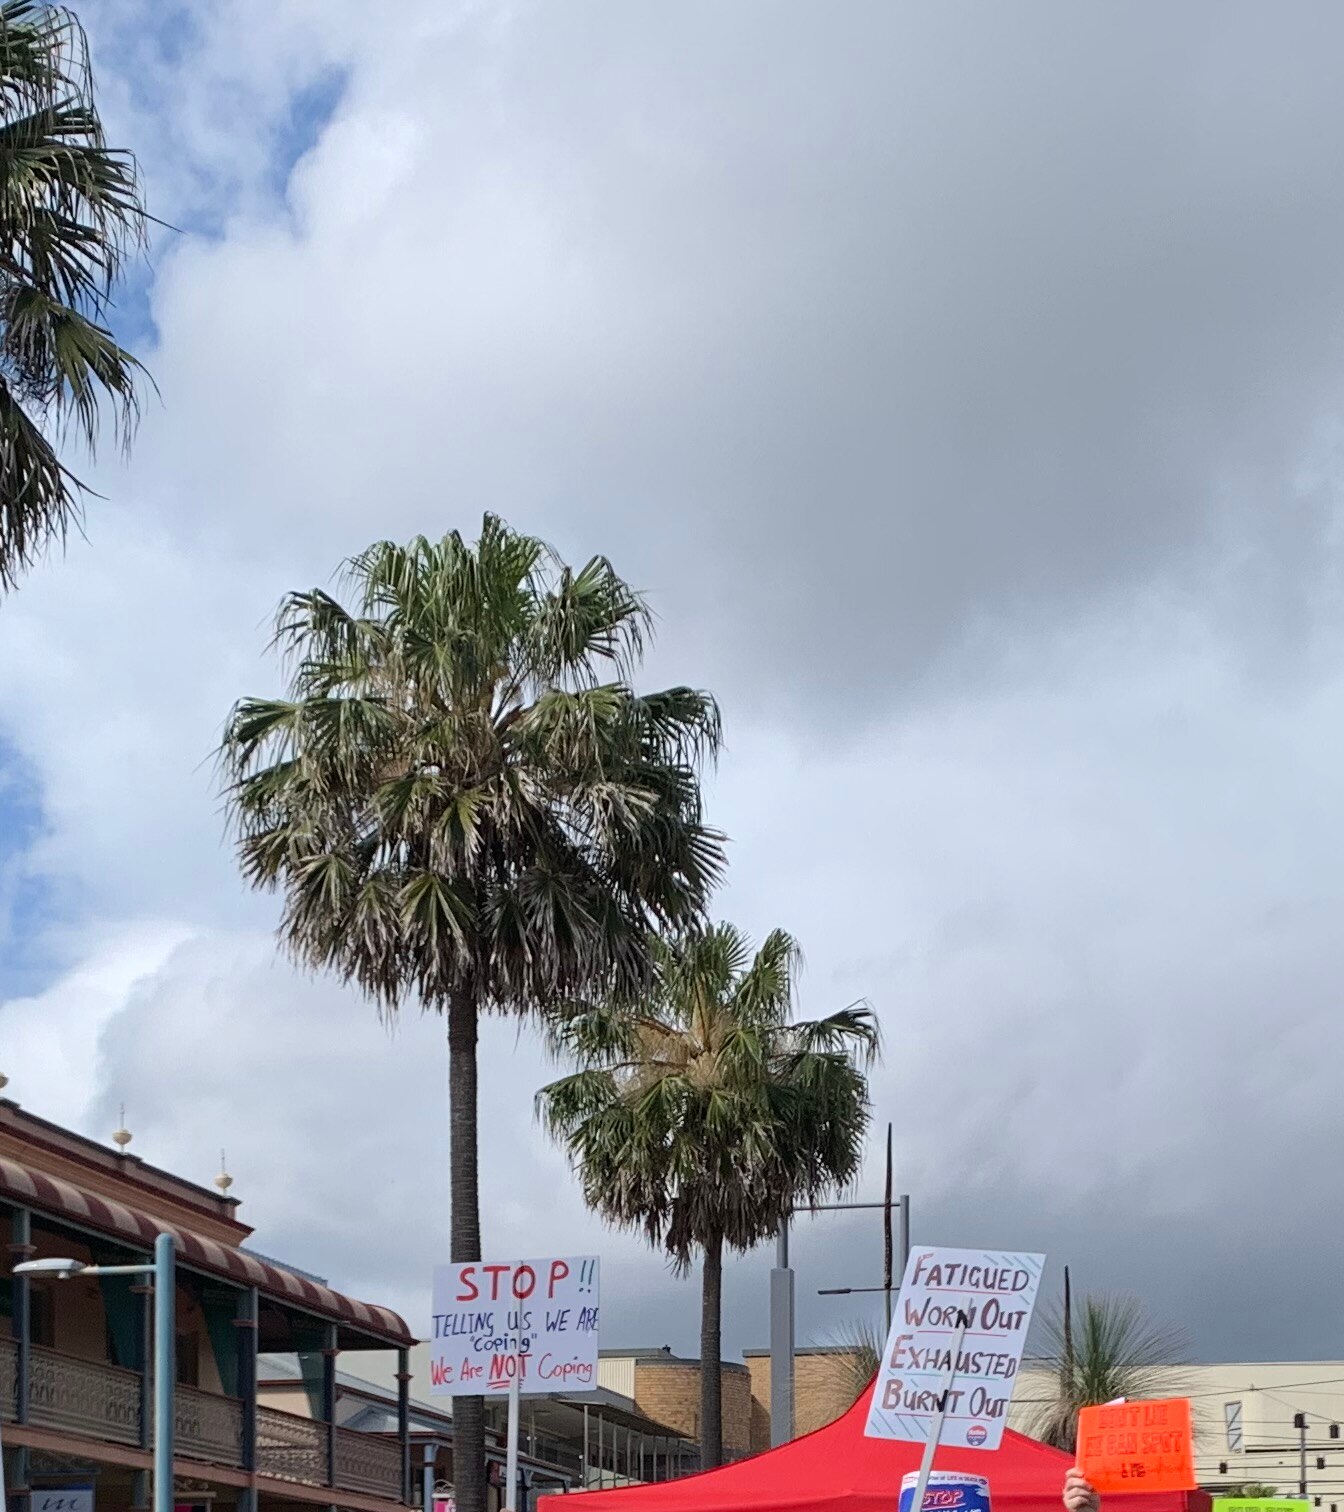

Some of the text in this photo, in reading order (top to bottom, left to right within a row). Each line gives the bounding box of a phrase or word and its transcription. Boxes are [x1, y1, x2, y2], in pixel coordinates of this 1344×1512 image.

[432, 1307, 599, 1339] TELLING US WE ARE
[460, 1357, 484, 1381] Are
[489, 1354, 533, 1380] NOT
[538, 1353, 593, 1383] Coping
